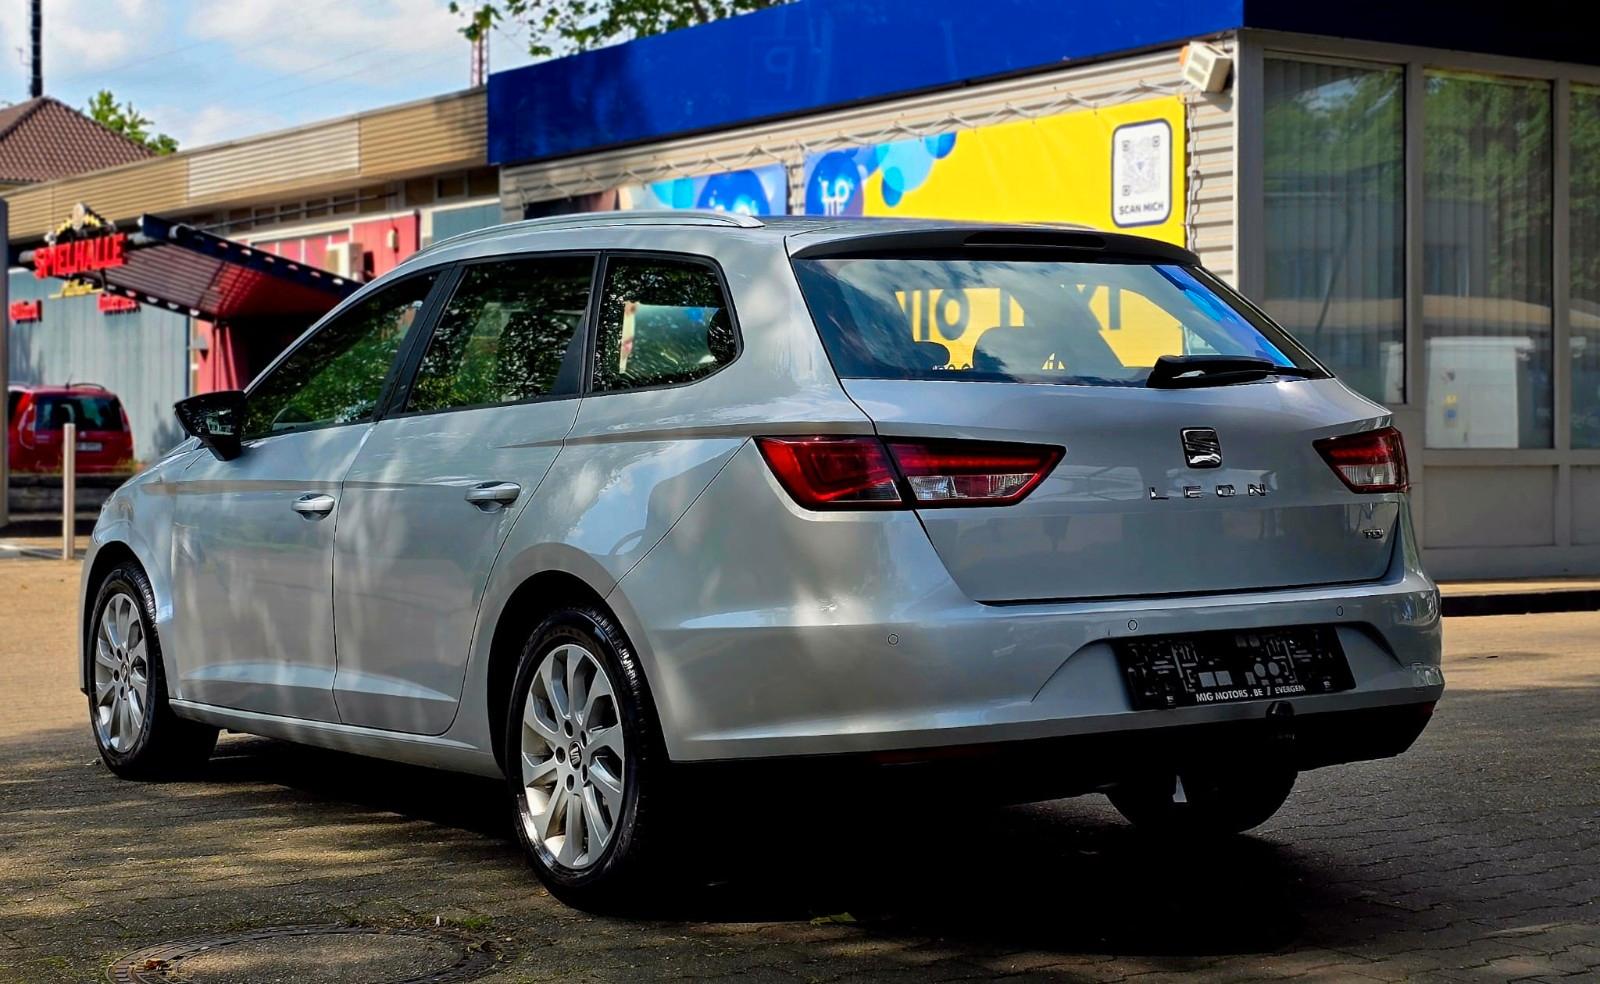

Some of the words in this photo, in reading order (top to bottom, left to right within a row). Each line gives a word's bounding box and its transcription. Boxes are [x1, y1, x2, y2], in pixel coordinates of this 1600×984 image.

[1119, 204, 1141, 215] SCAN
[1143, 202, 1164, 212] MICH
[33, 233, 126, 279] SPIELHALLE
[1149, 484, 1266, 499] LEON
[1196, 692, 1214, 702] MIG
[1215, 689, 1248, 701] MOTORS
[1275, 684, 1306, 694] EVERGEM
